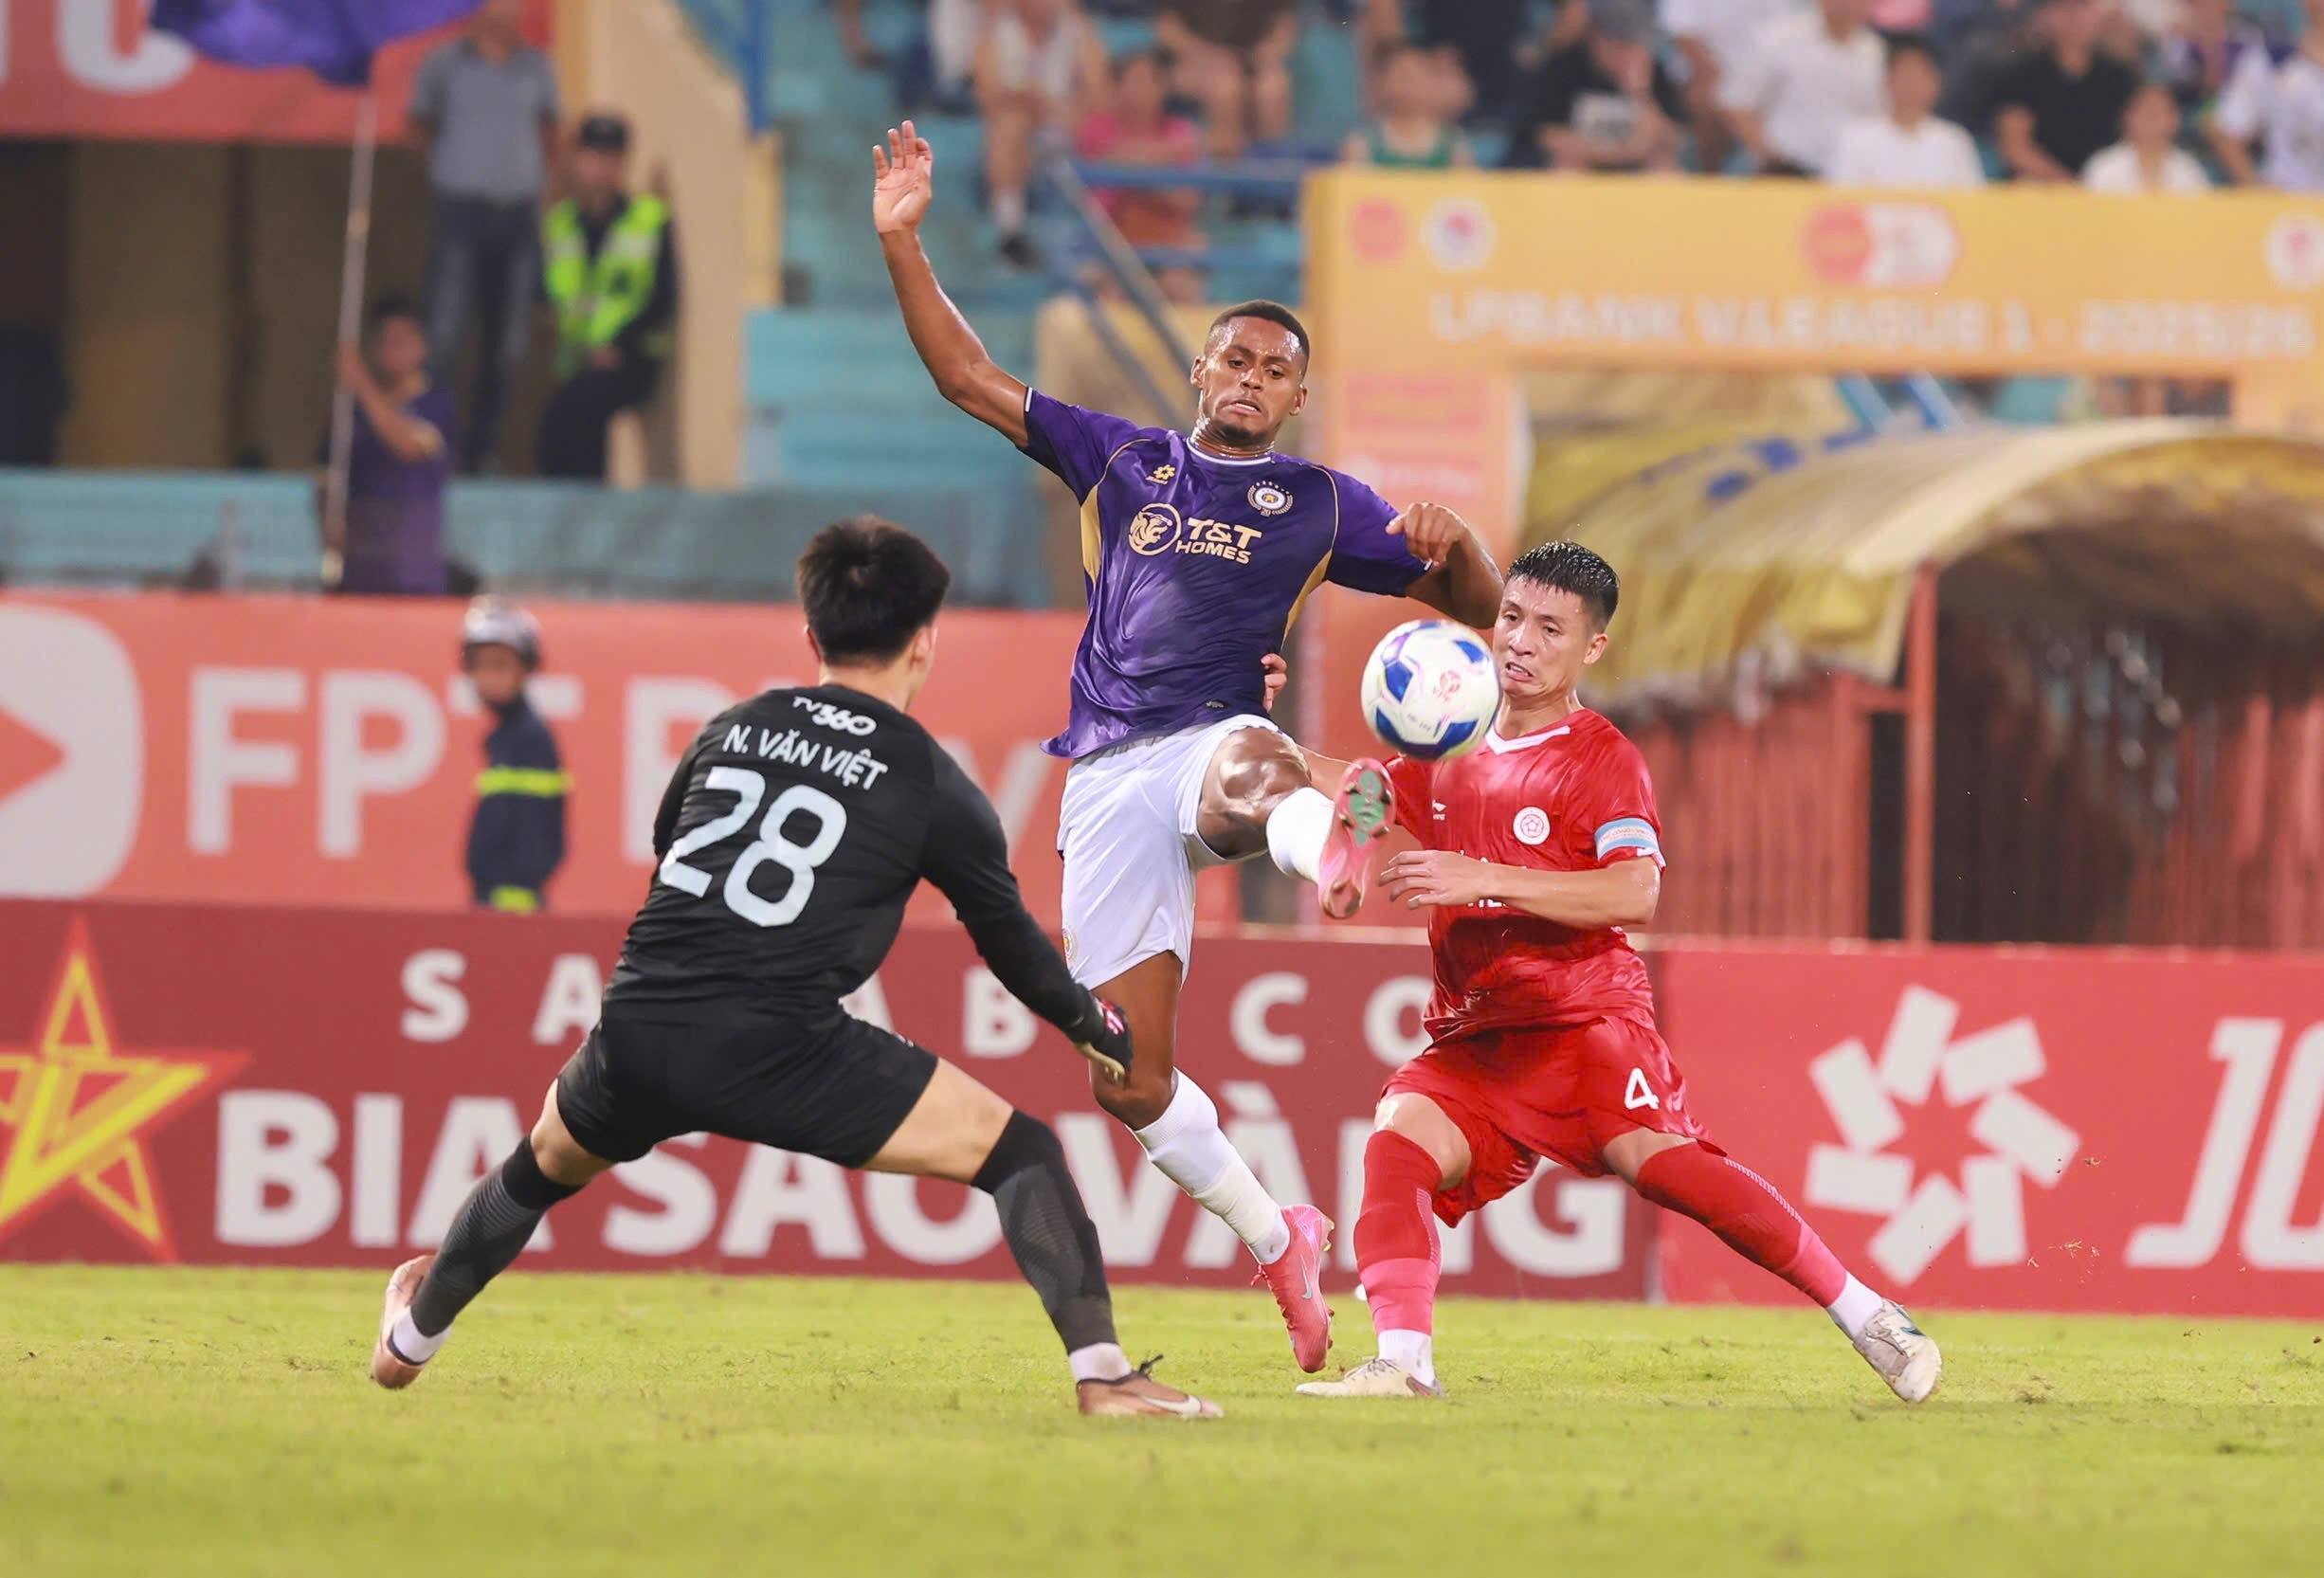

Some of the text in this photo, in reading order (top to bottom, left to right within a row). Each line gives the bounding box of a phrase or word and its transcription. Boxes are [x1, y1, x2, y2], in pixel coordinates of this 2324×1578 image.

[1174, 539, 1252, 565] HOMES
[1186, 517, 1262, 551] T&T
[792, 695, 878, 736] TV360
[721, 723, 889, 791] N. VĂN VIỆT
[659, 766, 847, 928] 28
[1624, 1067, 1660, 1111] 4
